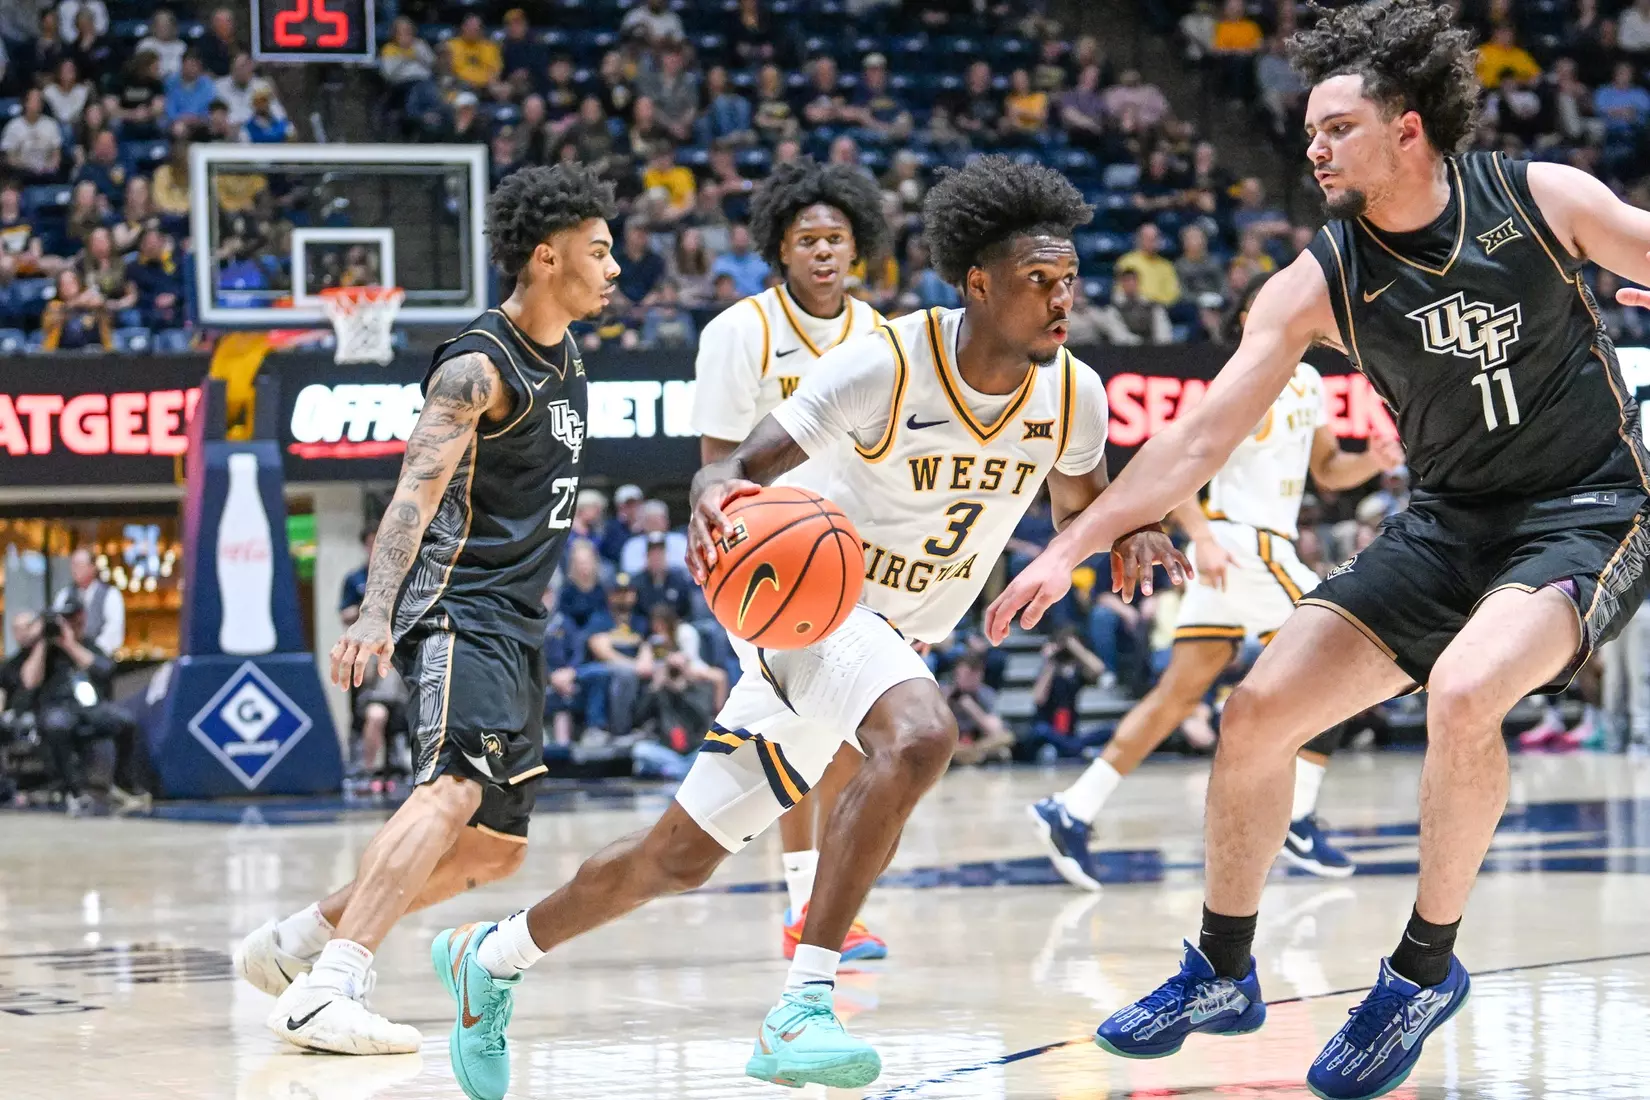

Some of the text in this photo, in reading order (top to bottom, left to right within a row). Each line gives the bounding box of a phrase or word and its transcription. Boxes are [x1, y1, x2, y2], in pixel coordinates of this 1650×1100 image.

[274, 0, 348, 48] 25
[1405, 291, 1522, 370] UCF
[290, 383, 425, 443] OFFIC
[1471, 367, 1520, 431] 11
[908, 454, 1036, 495] WEST
[923, 500, 985, 557] 3
